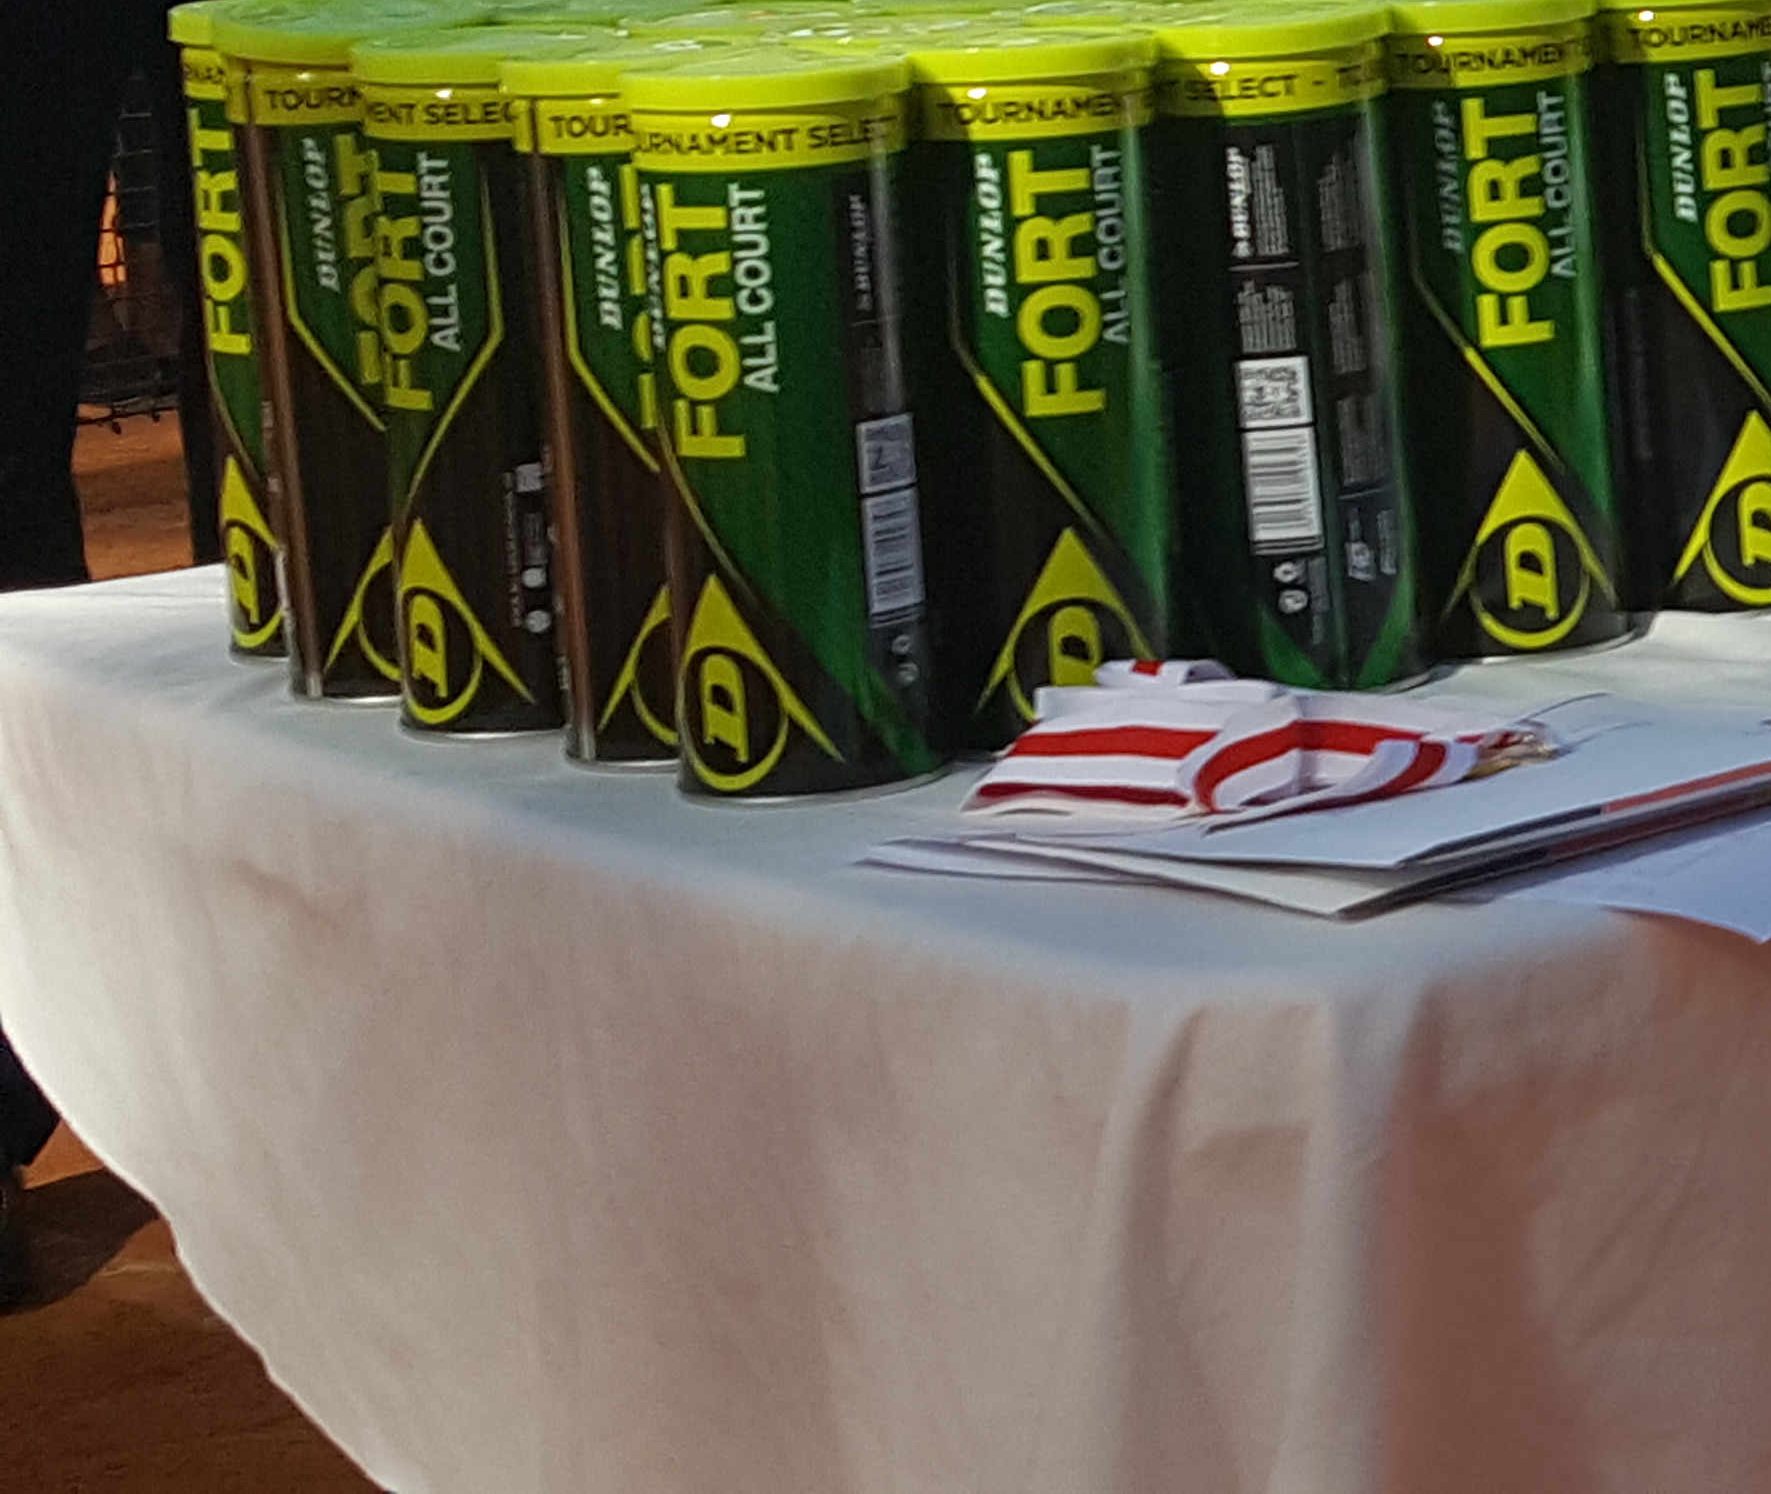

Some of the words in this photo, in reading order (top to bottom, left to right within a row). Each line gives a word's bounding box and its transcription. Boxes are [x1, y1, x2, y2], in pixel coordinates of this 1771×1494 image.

[190, 106, 252, 355] FORT
[302, 137, 341, 293] DUNLOP
[416, 151, 457, 277] COURT
[1460, 97, 1556, 350] FORT
[1663, 72, 1699, 224] DUNLOP
[373, 151, 435, 410] FORT
[429, 283, 462, 352] ALL
[585, 166, 624, 332] DUNLOP
[728, 182, 777, 315] COURT
[974, 153, 1011, 319] DUNLOP
[1006, 149, 1108, 419] FORT
[655, 182, 747, 459] FORT
[739, 320, 781, 395] ALL
